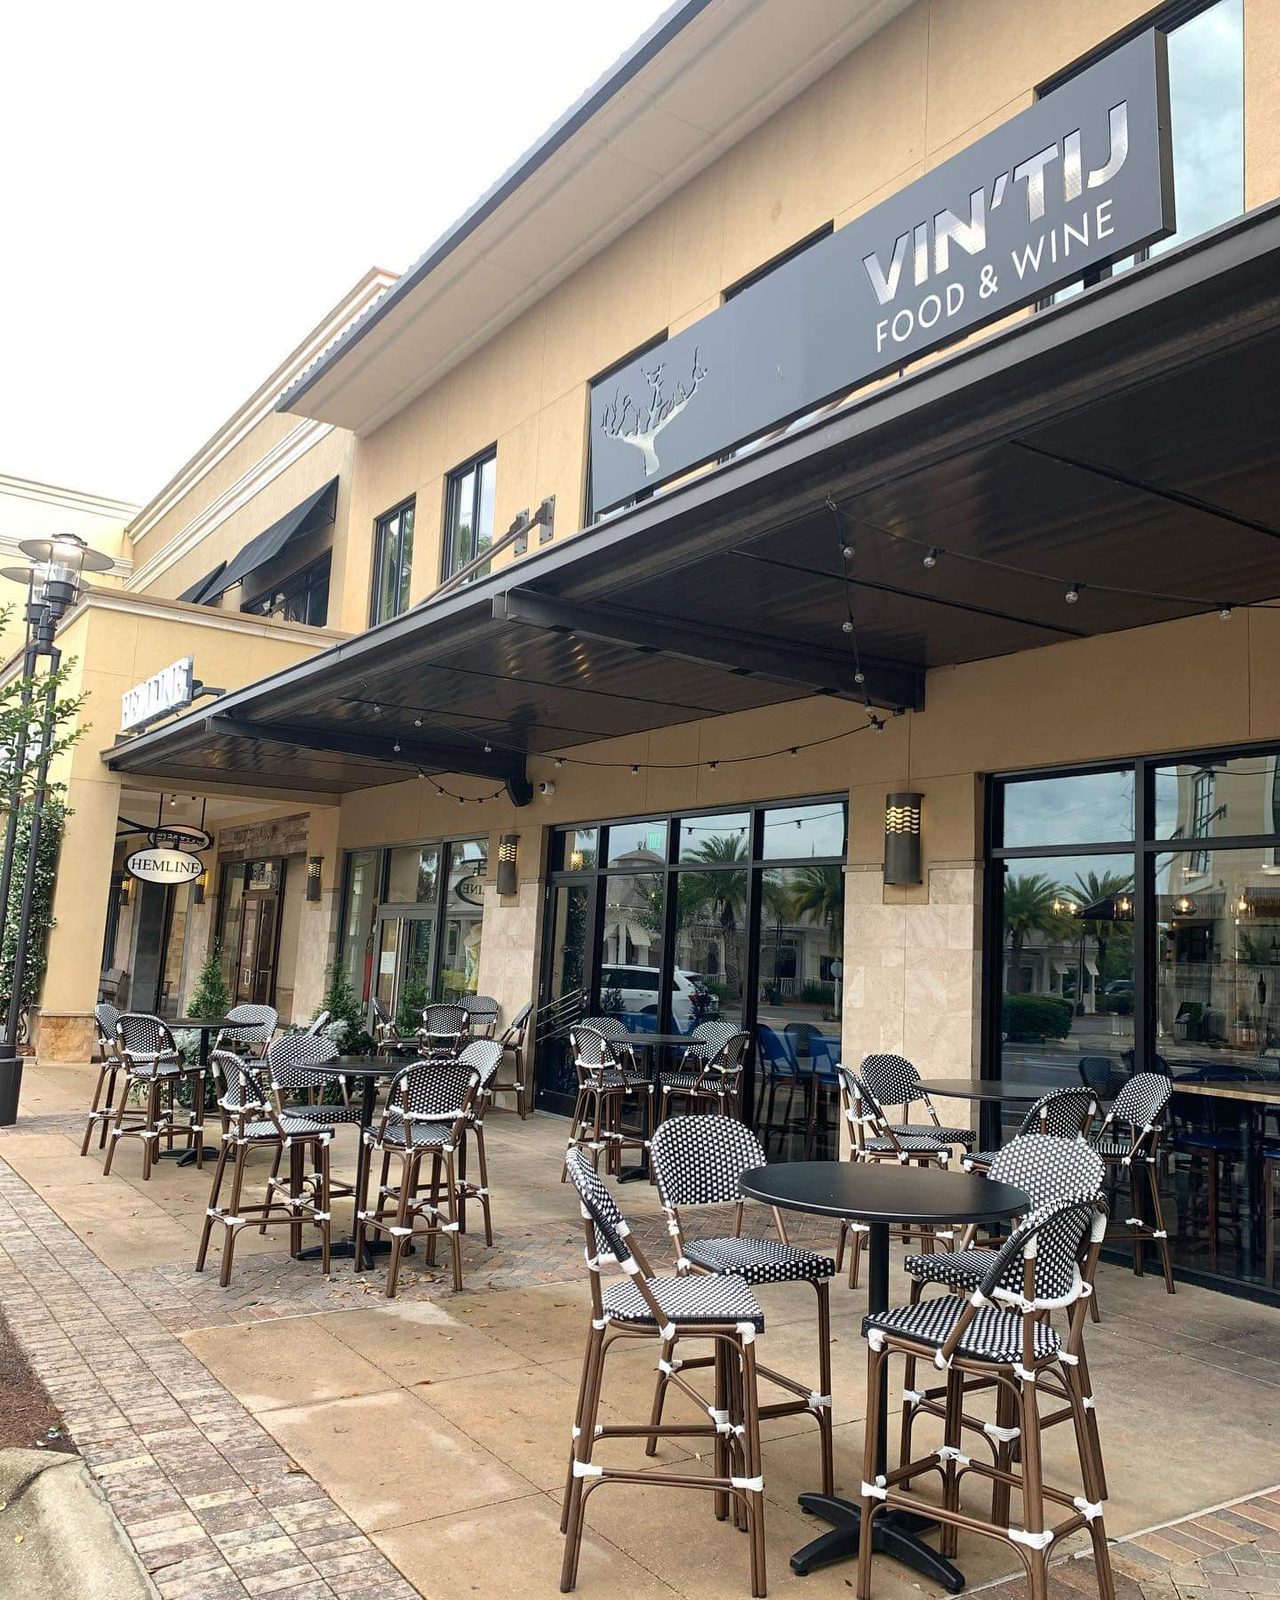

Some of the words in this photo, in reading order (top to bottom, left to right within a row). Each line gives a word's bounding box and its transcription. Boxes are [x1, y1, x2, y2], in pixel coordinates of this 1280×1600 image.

[862, 100, 1129, 305] VIN'TIJ
[876, 283, 964, 352] FOOD
[978, 264, 999, 298] &
[1011, 199, 1115, 280] WINE
[131, 858, 200, 874] HEMLINE
